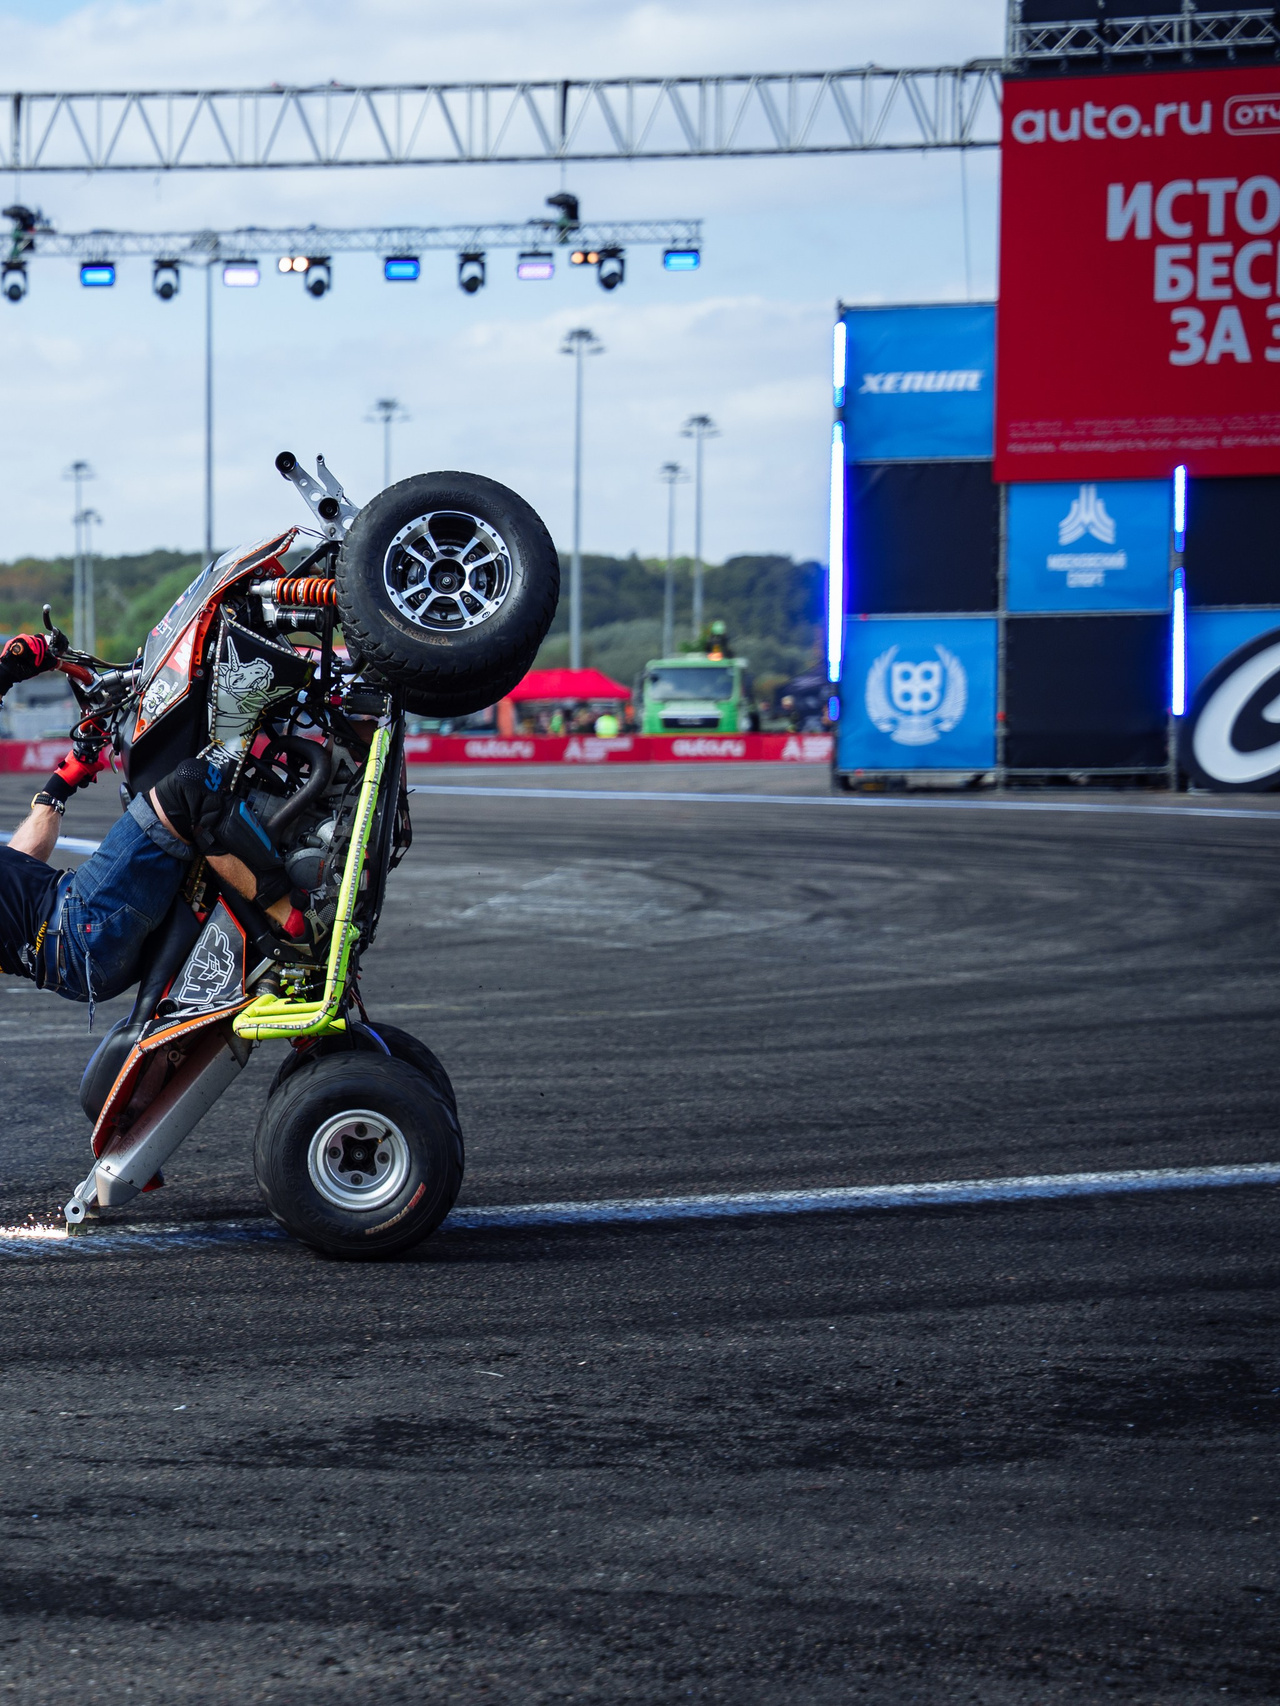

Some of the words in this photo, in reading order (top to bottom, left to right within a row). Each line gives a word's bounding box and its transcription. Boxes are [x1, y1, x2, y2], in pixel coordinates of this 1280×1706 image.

[1011, 100, 1212, 144] auto.ru
[1153, 239, 1280, 302] БЕС
[1169, 305, 1252, 366] ЗА
